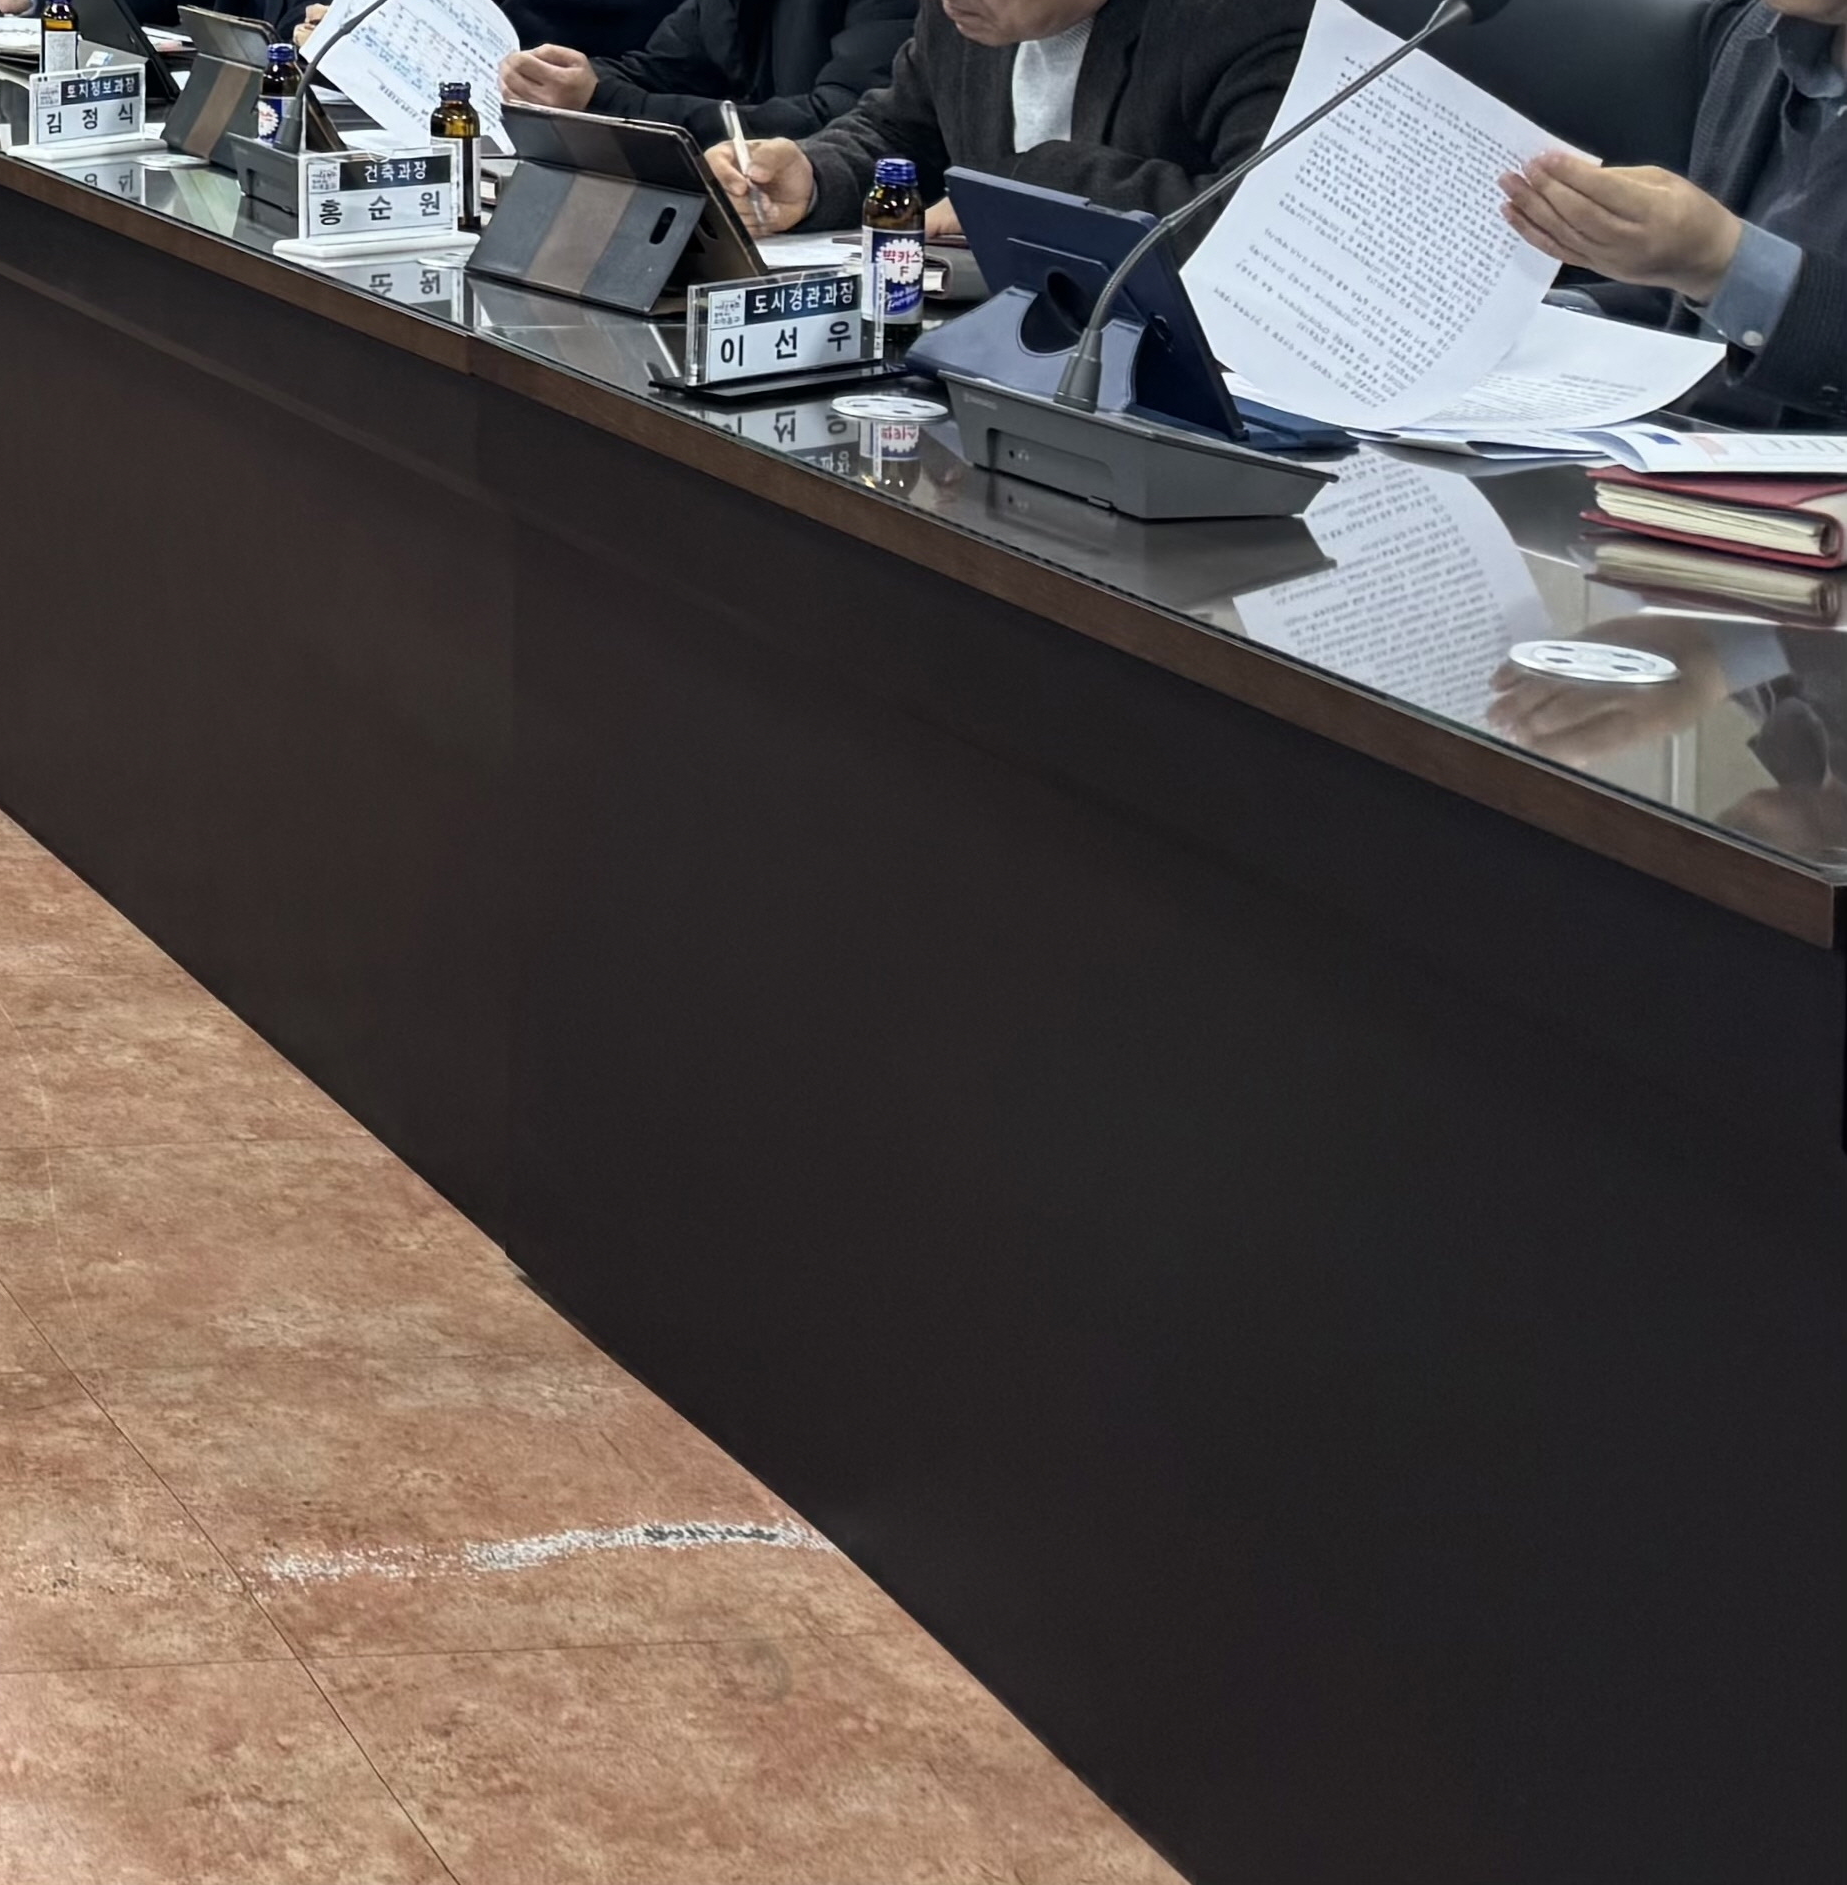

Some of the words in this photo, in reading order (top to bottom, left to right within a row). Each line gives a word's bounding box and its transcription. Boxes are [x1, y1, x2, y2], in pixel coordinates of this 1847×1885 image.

[66, 76, 135, 99] 토지정보과장
[364, 160, 427, 183] 건축과장
[882, 250, 921, 264] 박카스
[900, 266, 910, 278] F
[752, 281, 854, 314] 도시경관과장
